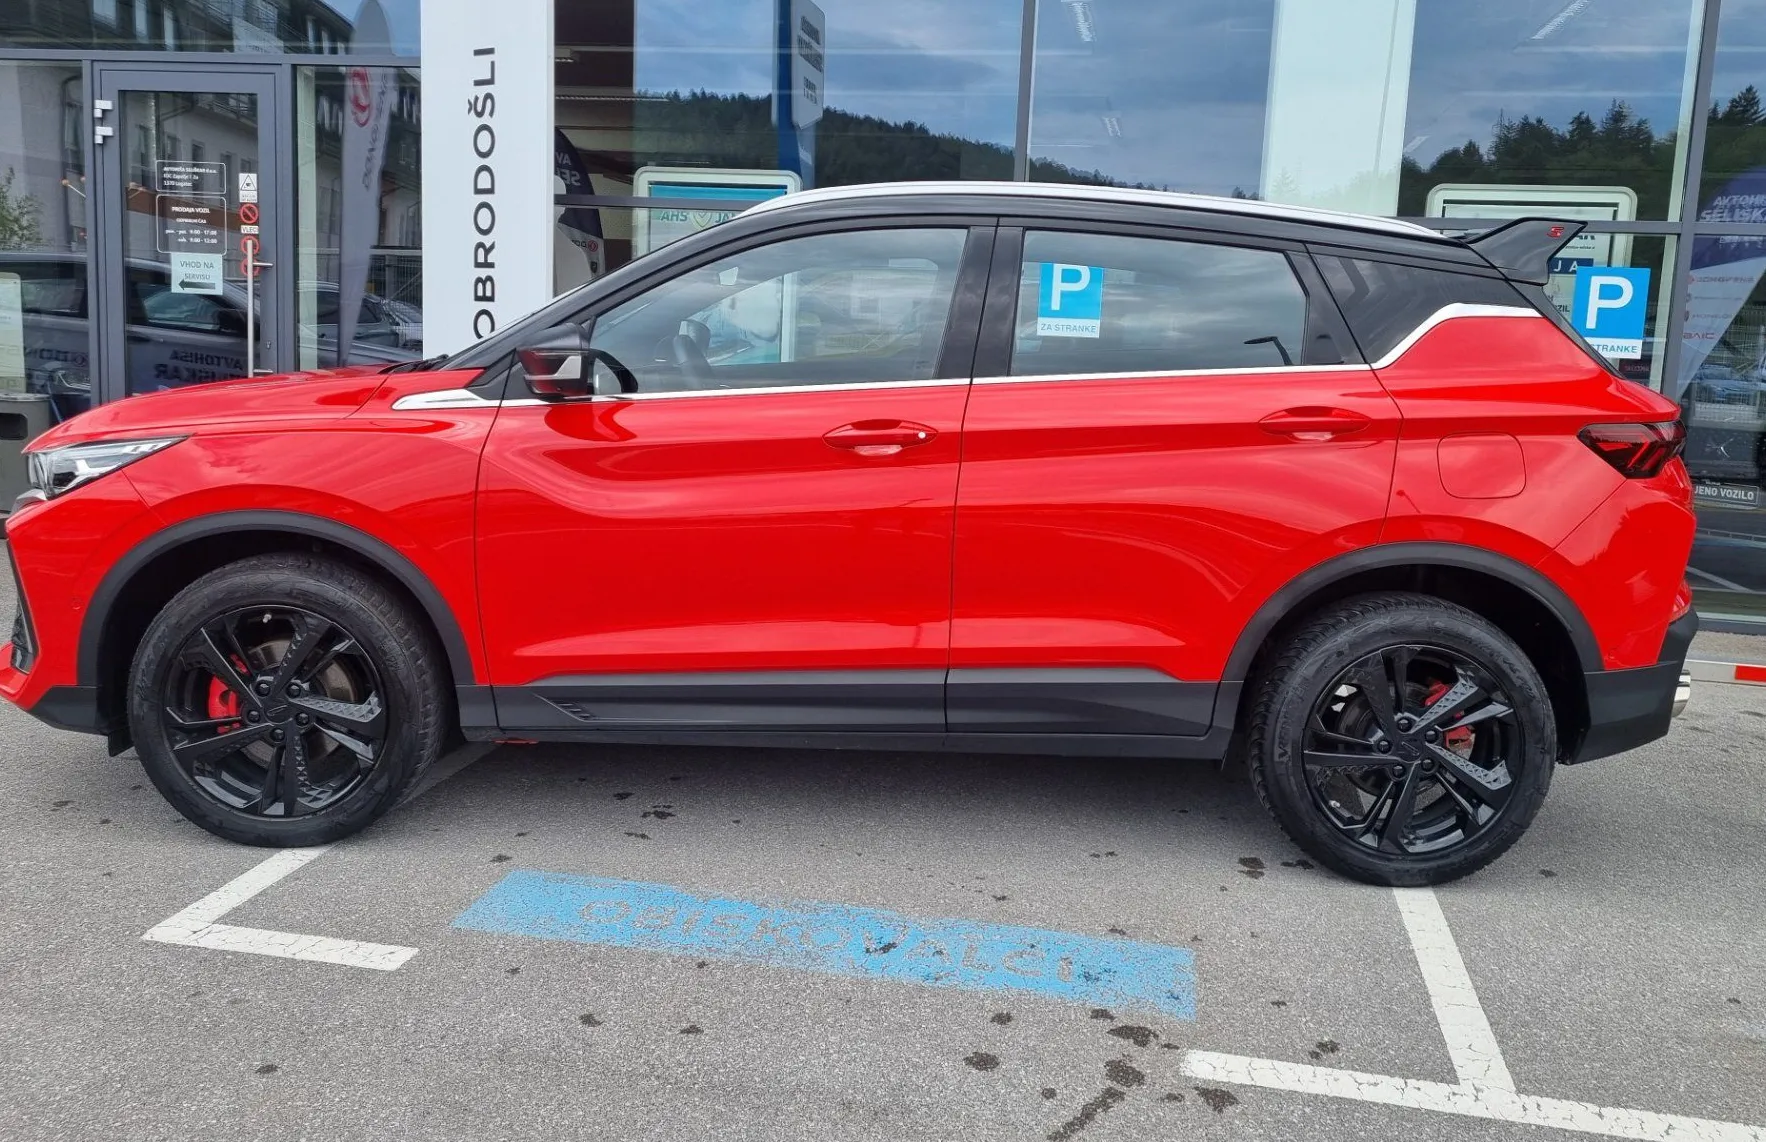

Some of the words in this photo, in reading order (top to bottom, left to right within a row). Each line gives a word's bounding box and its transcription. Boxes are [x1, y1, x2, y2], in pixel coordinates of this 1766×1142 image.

[660, 210, 688, 222] AHS
[180, 260, 202, 269] VHOD
[203, 261, 215, 269] NA
[1051, 264, 1091, 311] P
[1585, 275, 1634, 329] P
[1040, 323, 1053, 332] ZA
[1054, 324, 1097, 334] STRANKE
[1720, 488, 1755, 501] VOZILO
